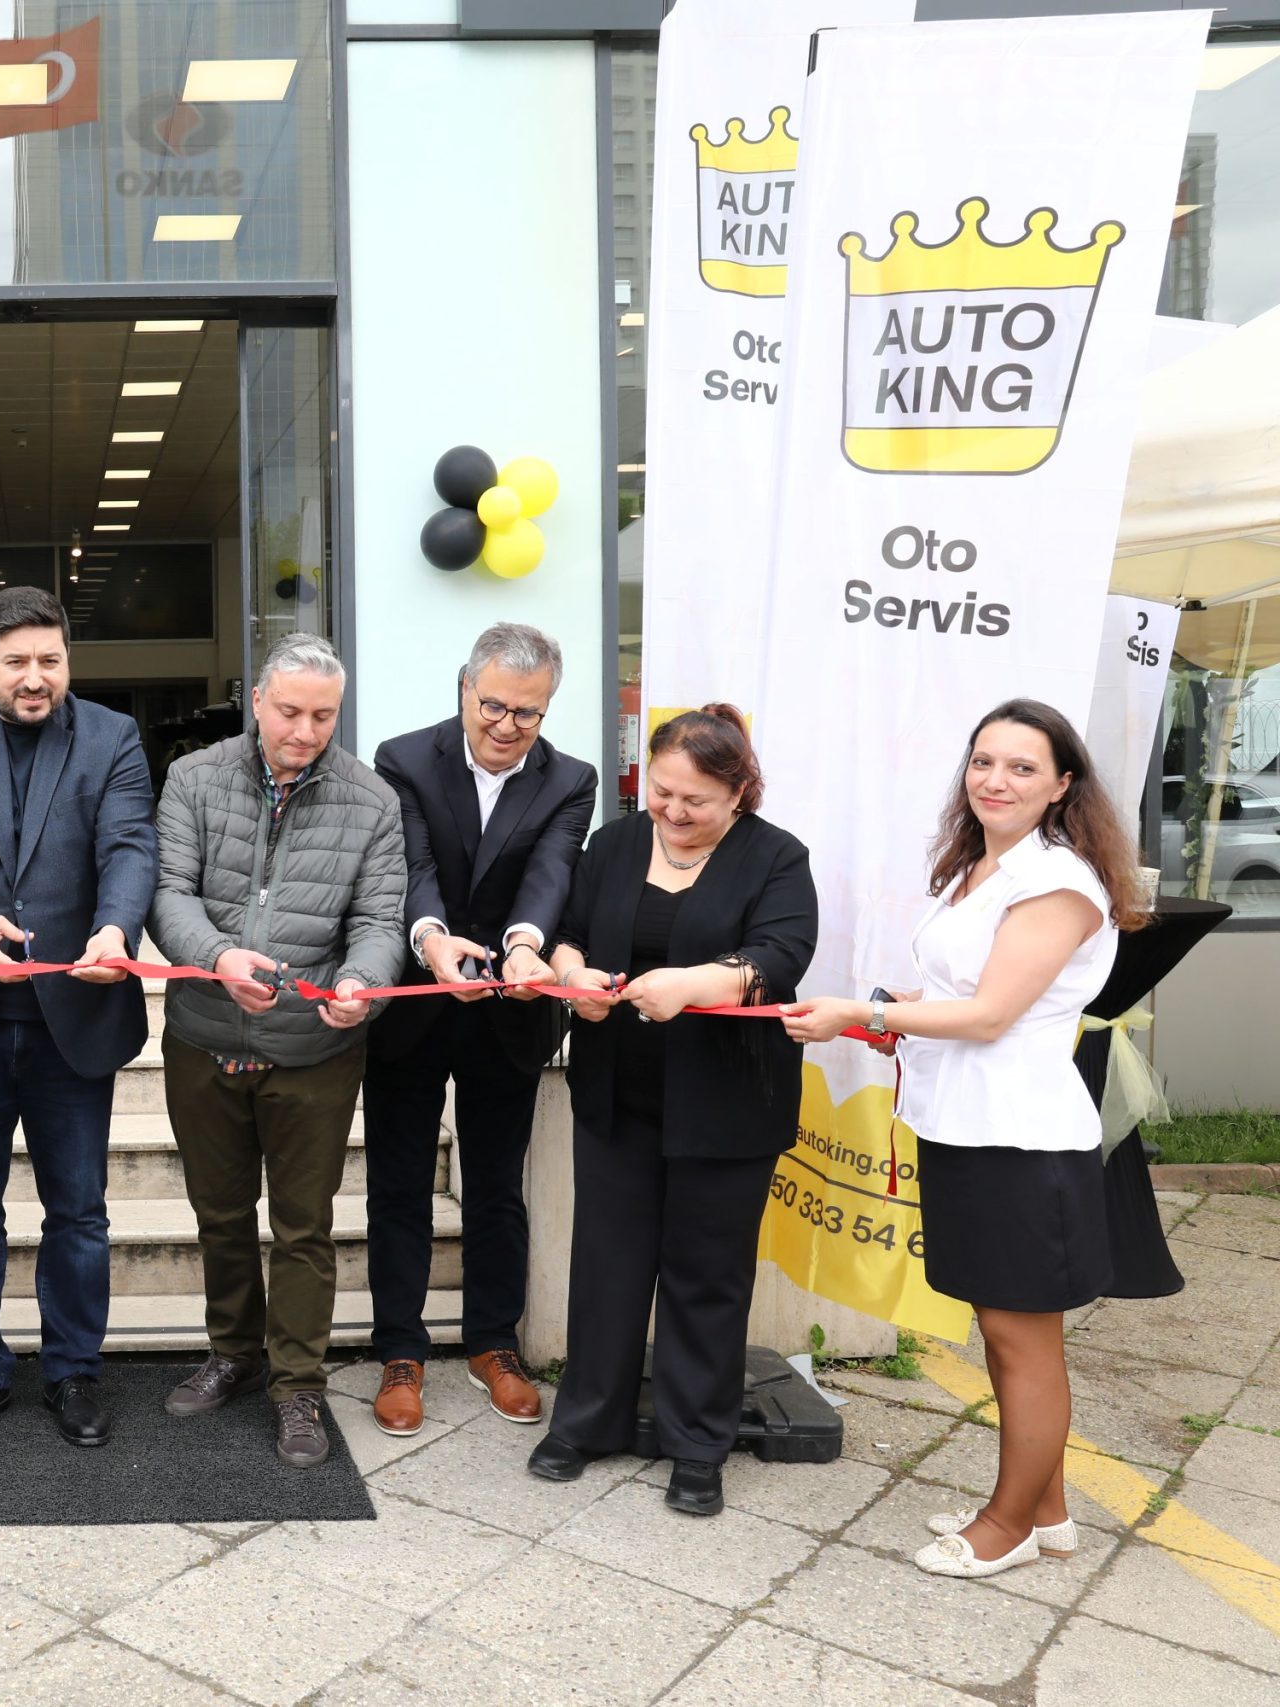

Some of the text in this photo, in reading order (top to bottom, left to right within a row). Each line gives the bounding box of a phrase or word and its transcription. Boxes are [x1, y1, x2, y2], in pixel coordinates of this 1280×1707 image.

[717, 180, 795, 216] AUT
[720, 219, 787, 256] KIN
[873, 302, 1056, 356] AUTO
[703, 370, 778, 405] Serv
[875, 363, 1033, 414] KING
[881, 525, 977, 573] Oto
[844, 579, 1011, 637] Servis
[796, 1124, 919, 1182] autoking.co
[770, 1173, 925, 1258] 50 333 54 6
